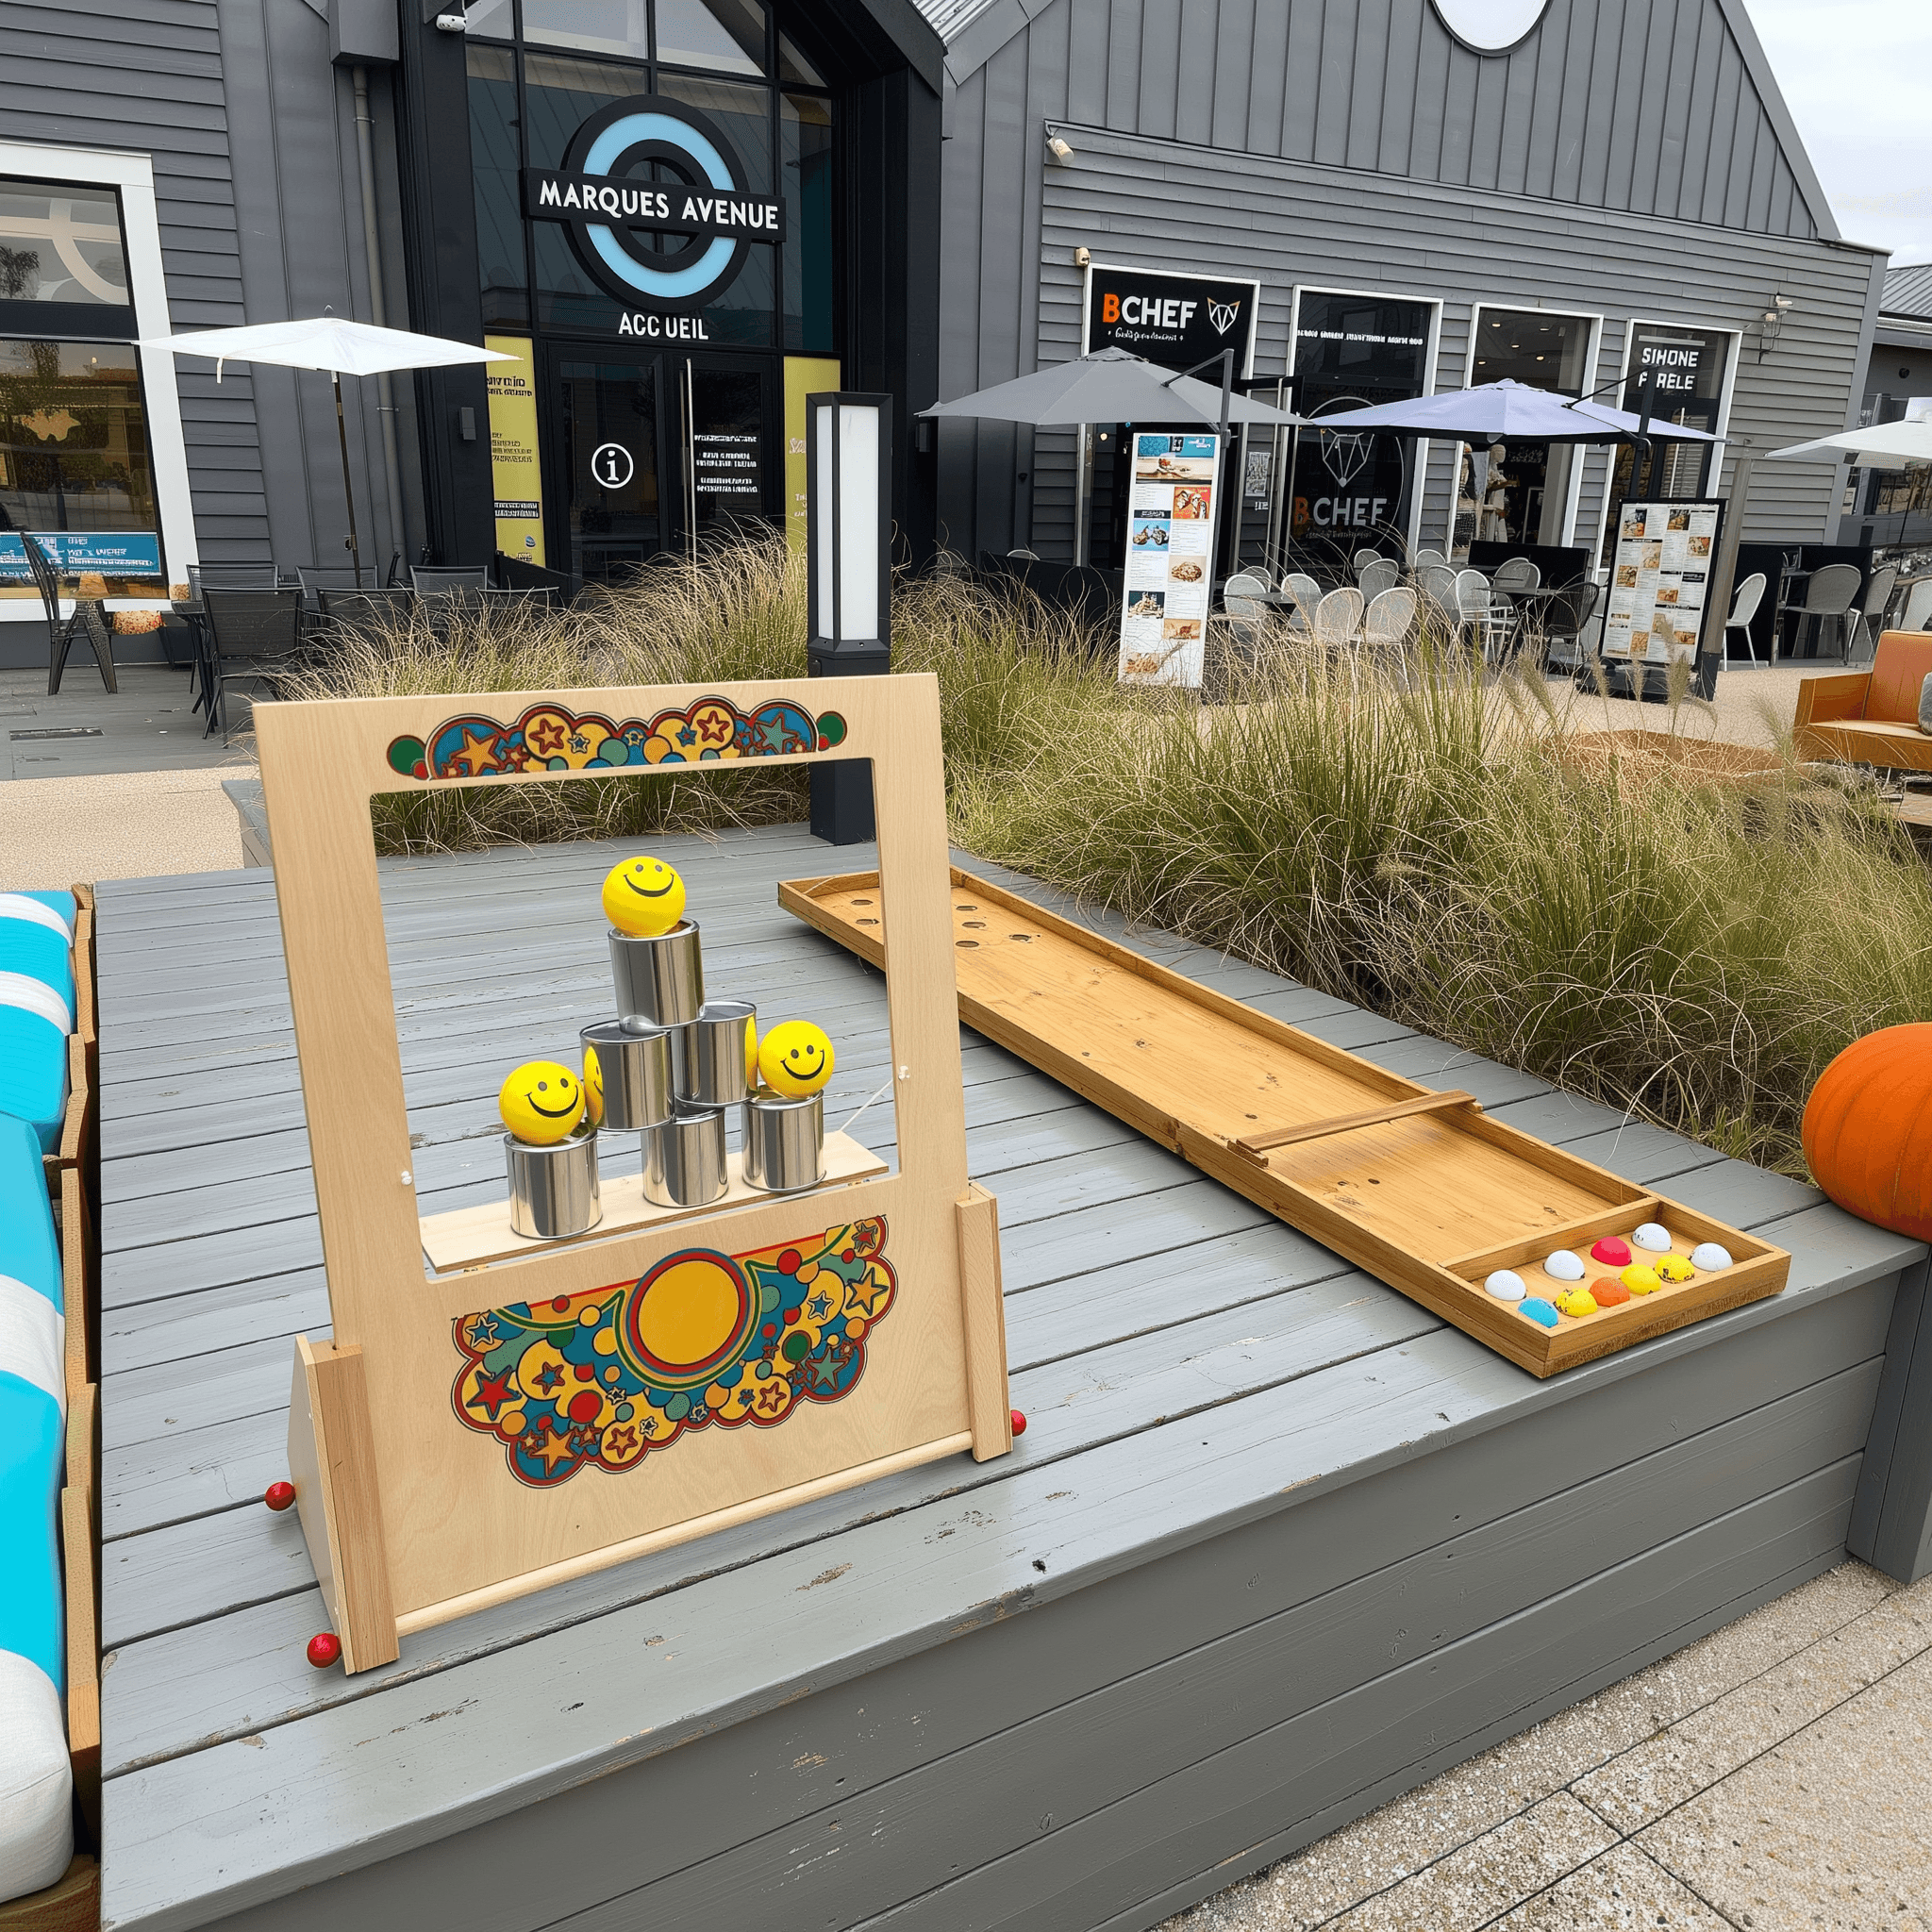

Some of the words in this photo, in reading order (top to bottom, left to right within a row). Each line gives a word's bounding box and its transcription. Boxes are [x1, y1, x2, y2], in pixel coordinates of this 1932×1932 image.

[540, 179, 670, 219] MARQUES
[681, 197, 779, 230] AVENUE
[1102, 293, 1198, 329] BCHEF
